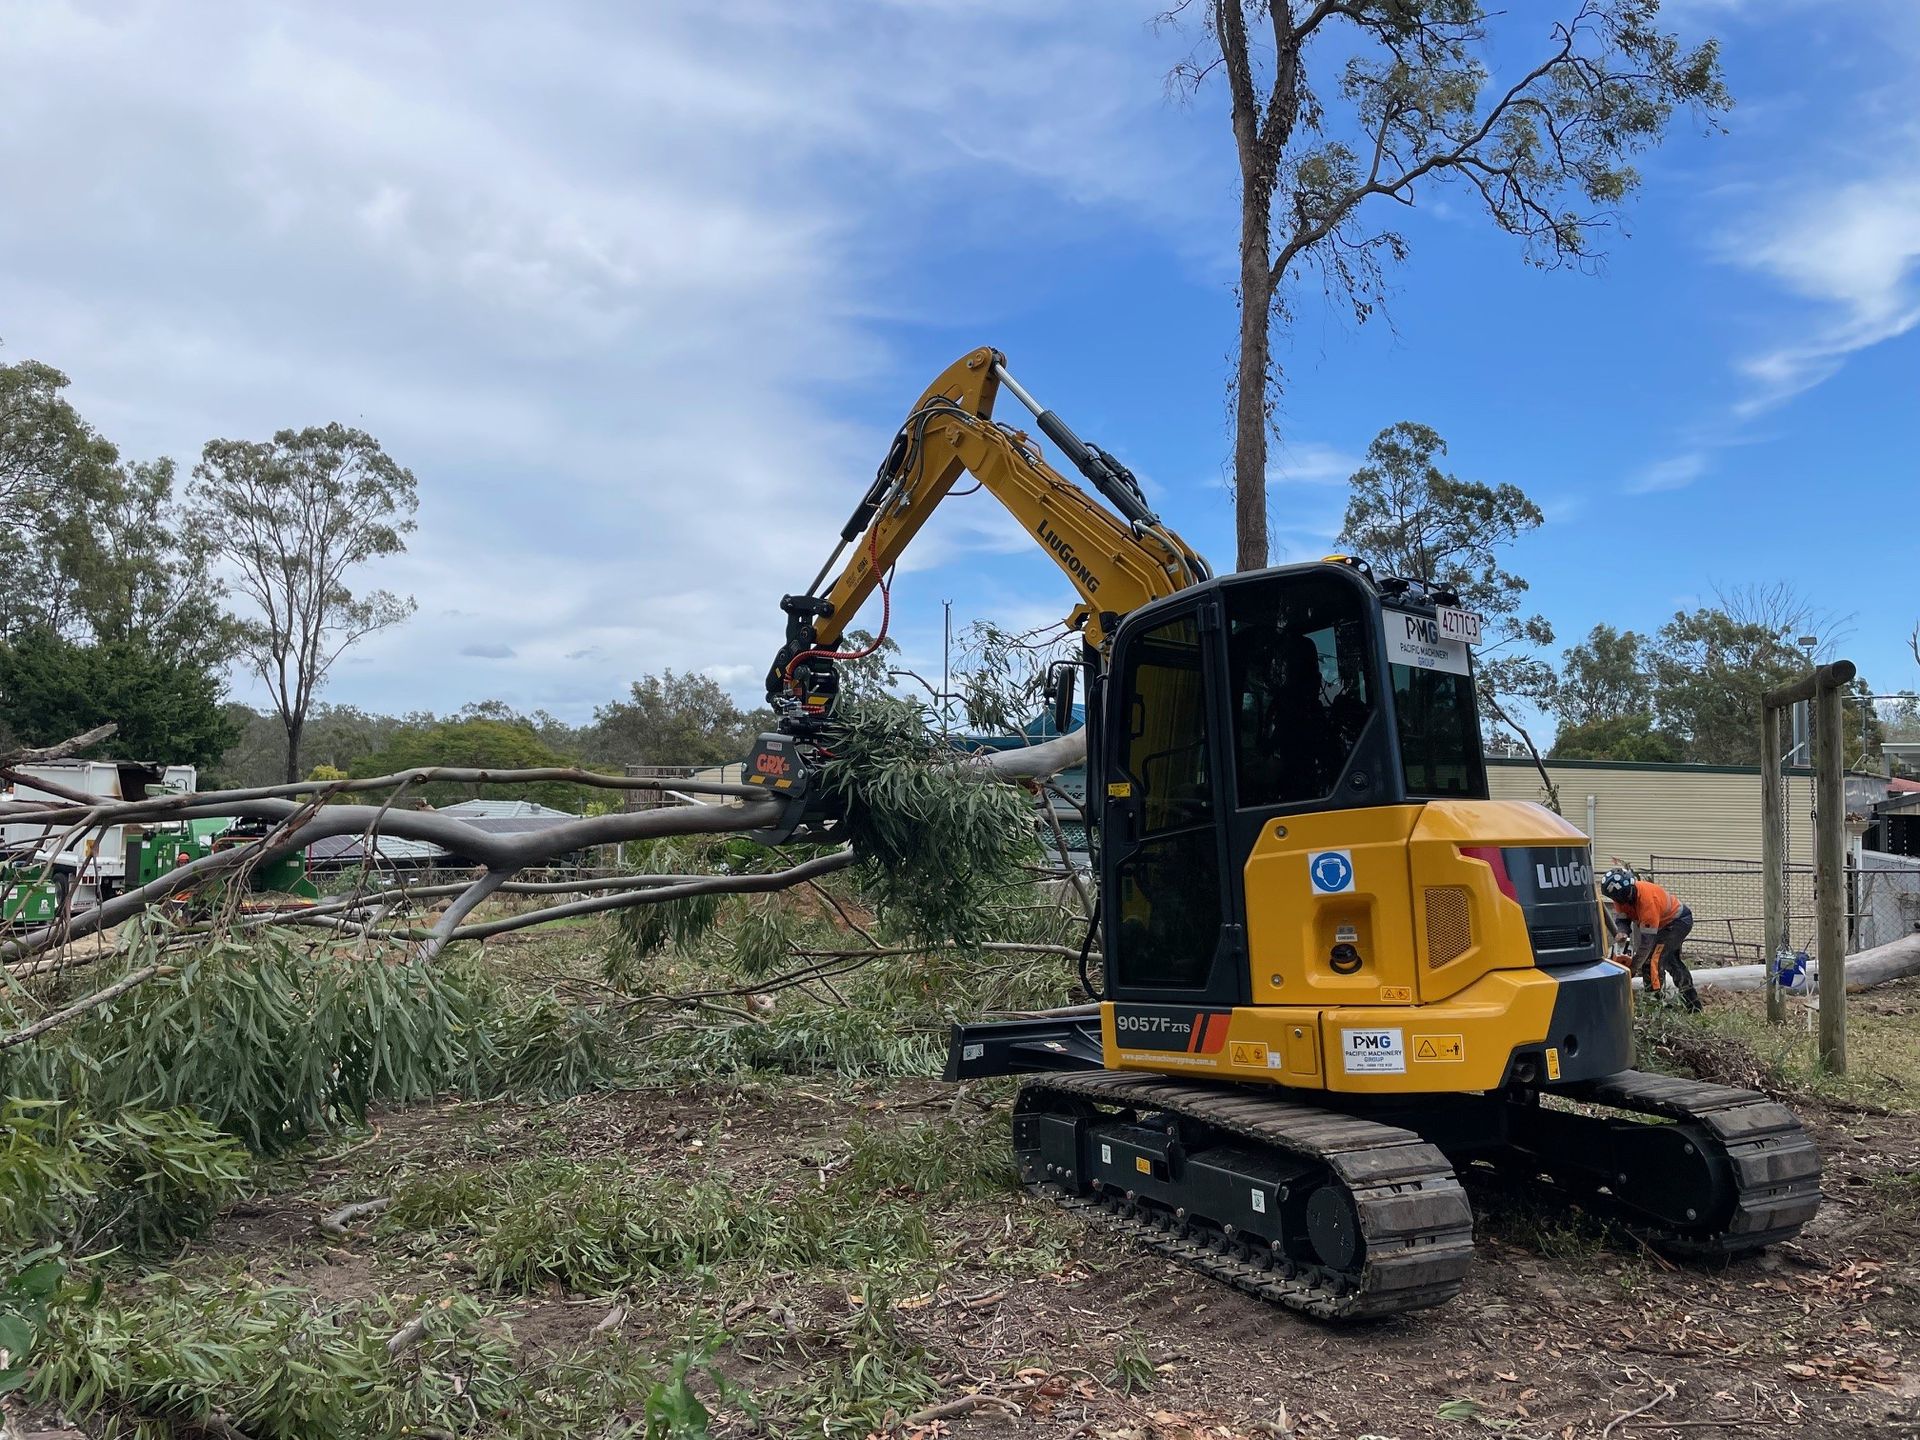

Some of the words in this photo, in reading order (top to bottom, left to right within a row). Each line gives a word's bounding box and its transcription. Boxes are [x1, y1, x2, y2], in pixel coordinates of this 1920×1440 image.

[1405, 616, 1438, 645] PMG
[1443, 611, 1477, 637] 4277C3
[1400, 643, 1420, 655] PACIFIC
[1420, 646, 1448, 660] MACHINERY
[1418, 656, 1434, 667] GROUP
[1353, 1035, 1391, 1049] PMG
